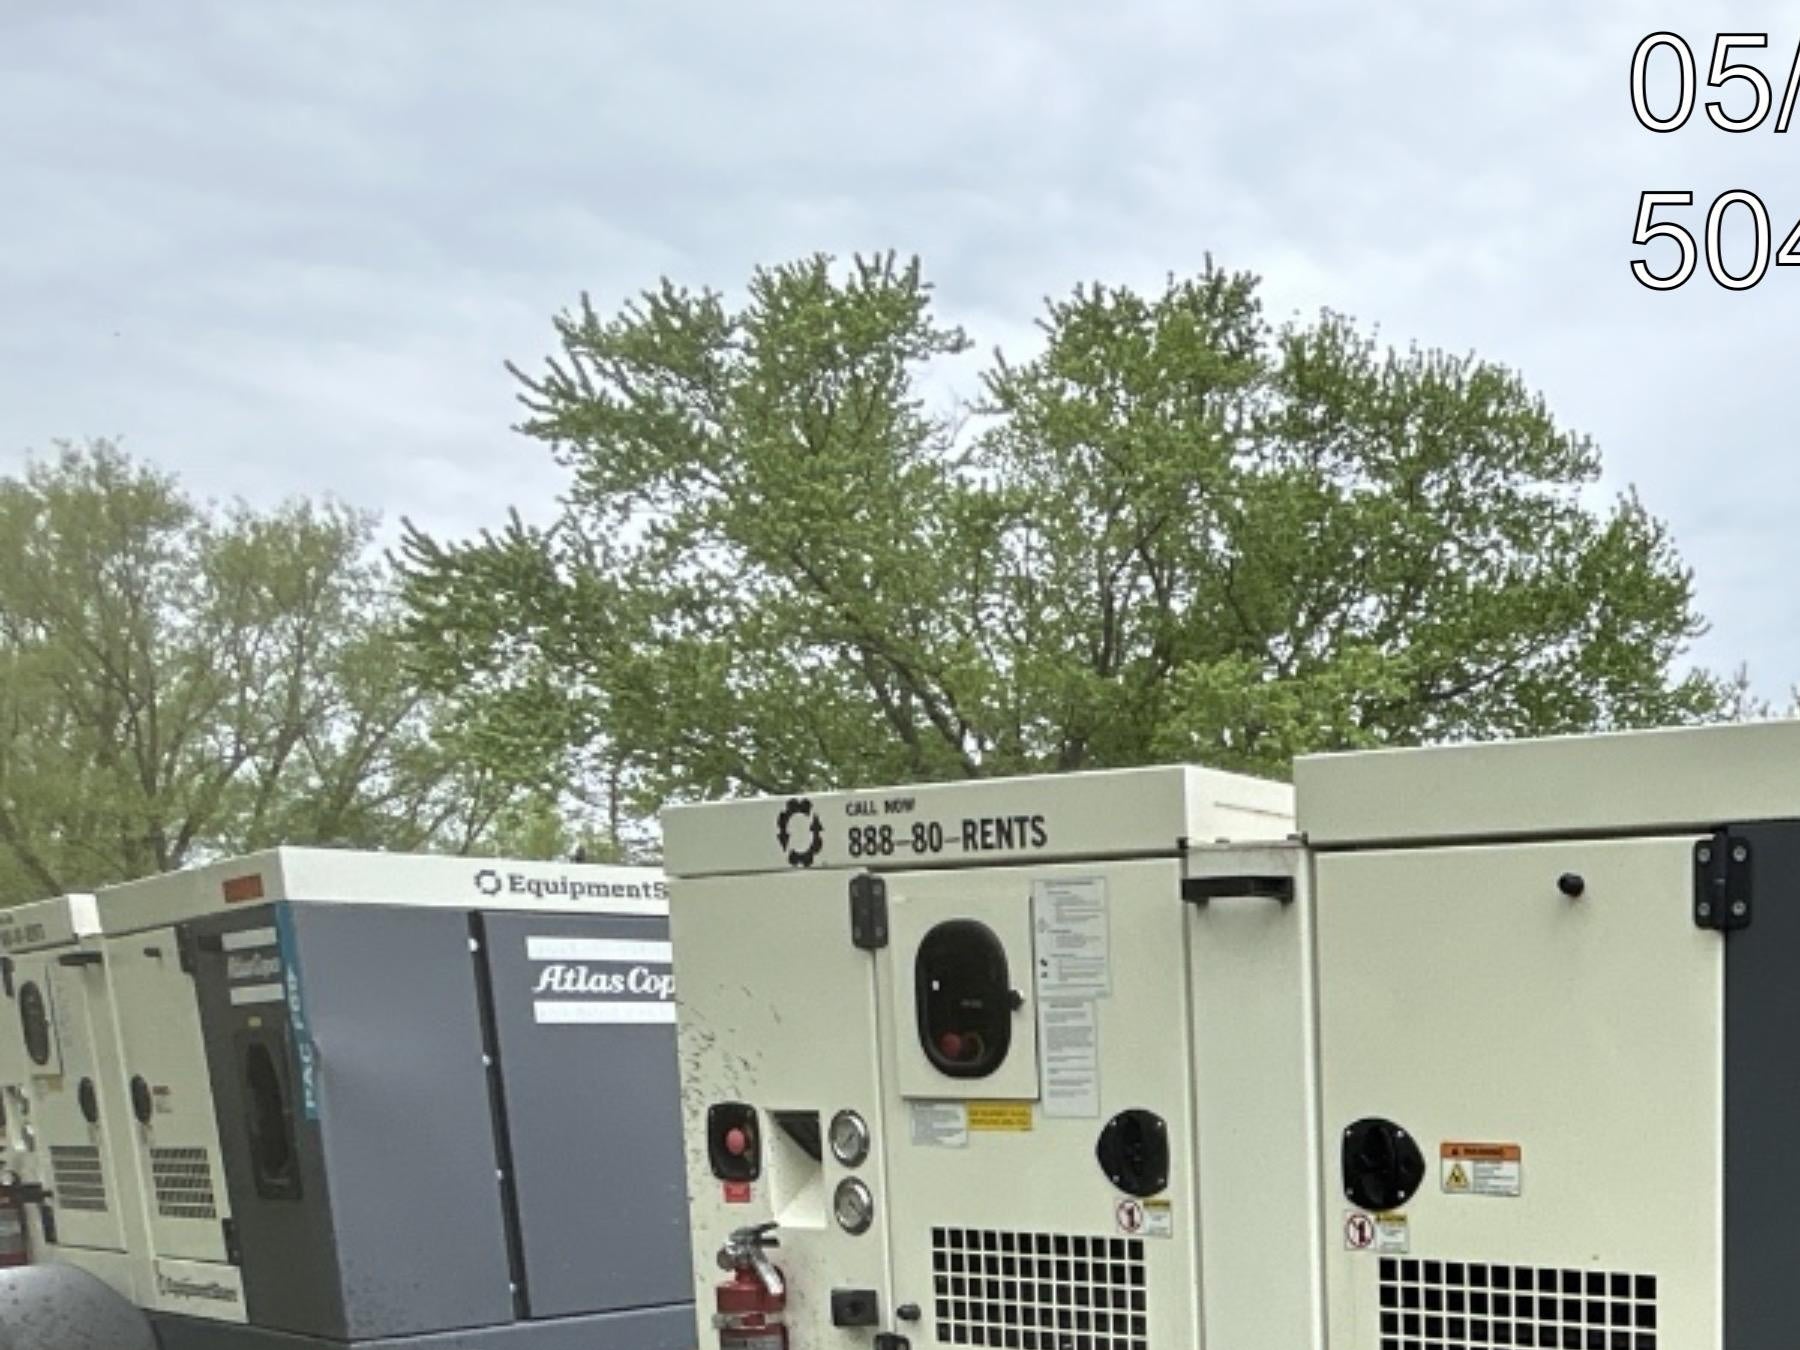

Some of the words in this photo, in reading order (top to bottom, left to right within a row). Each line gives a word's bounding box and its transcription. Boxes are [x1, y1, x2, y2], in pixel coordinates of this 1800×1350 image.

[845, 801, 878, 817] CALL
[884, 797, 916, 815] NOW
[848, 815, 1049, 858] 888-80-RENTS
[507, 873, 669, 900] EquipmentS
